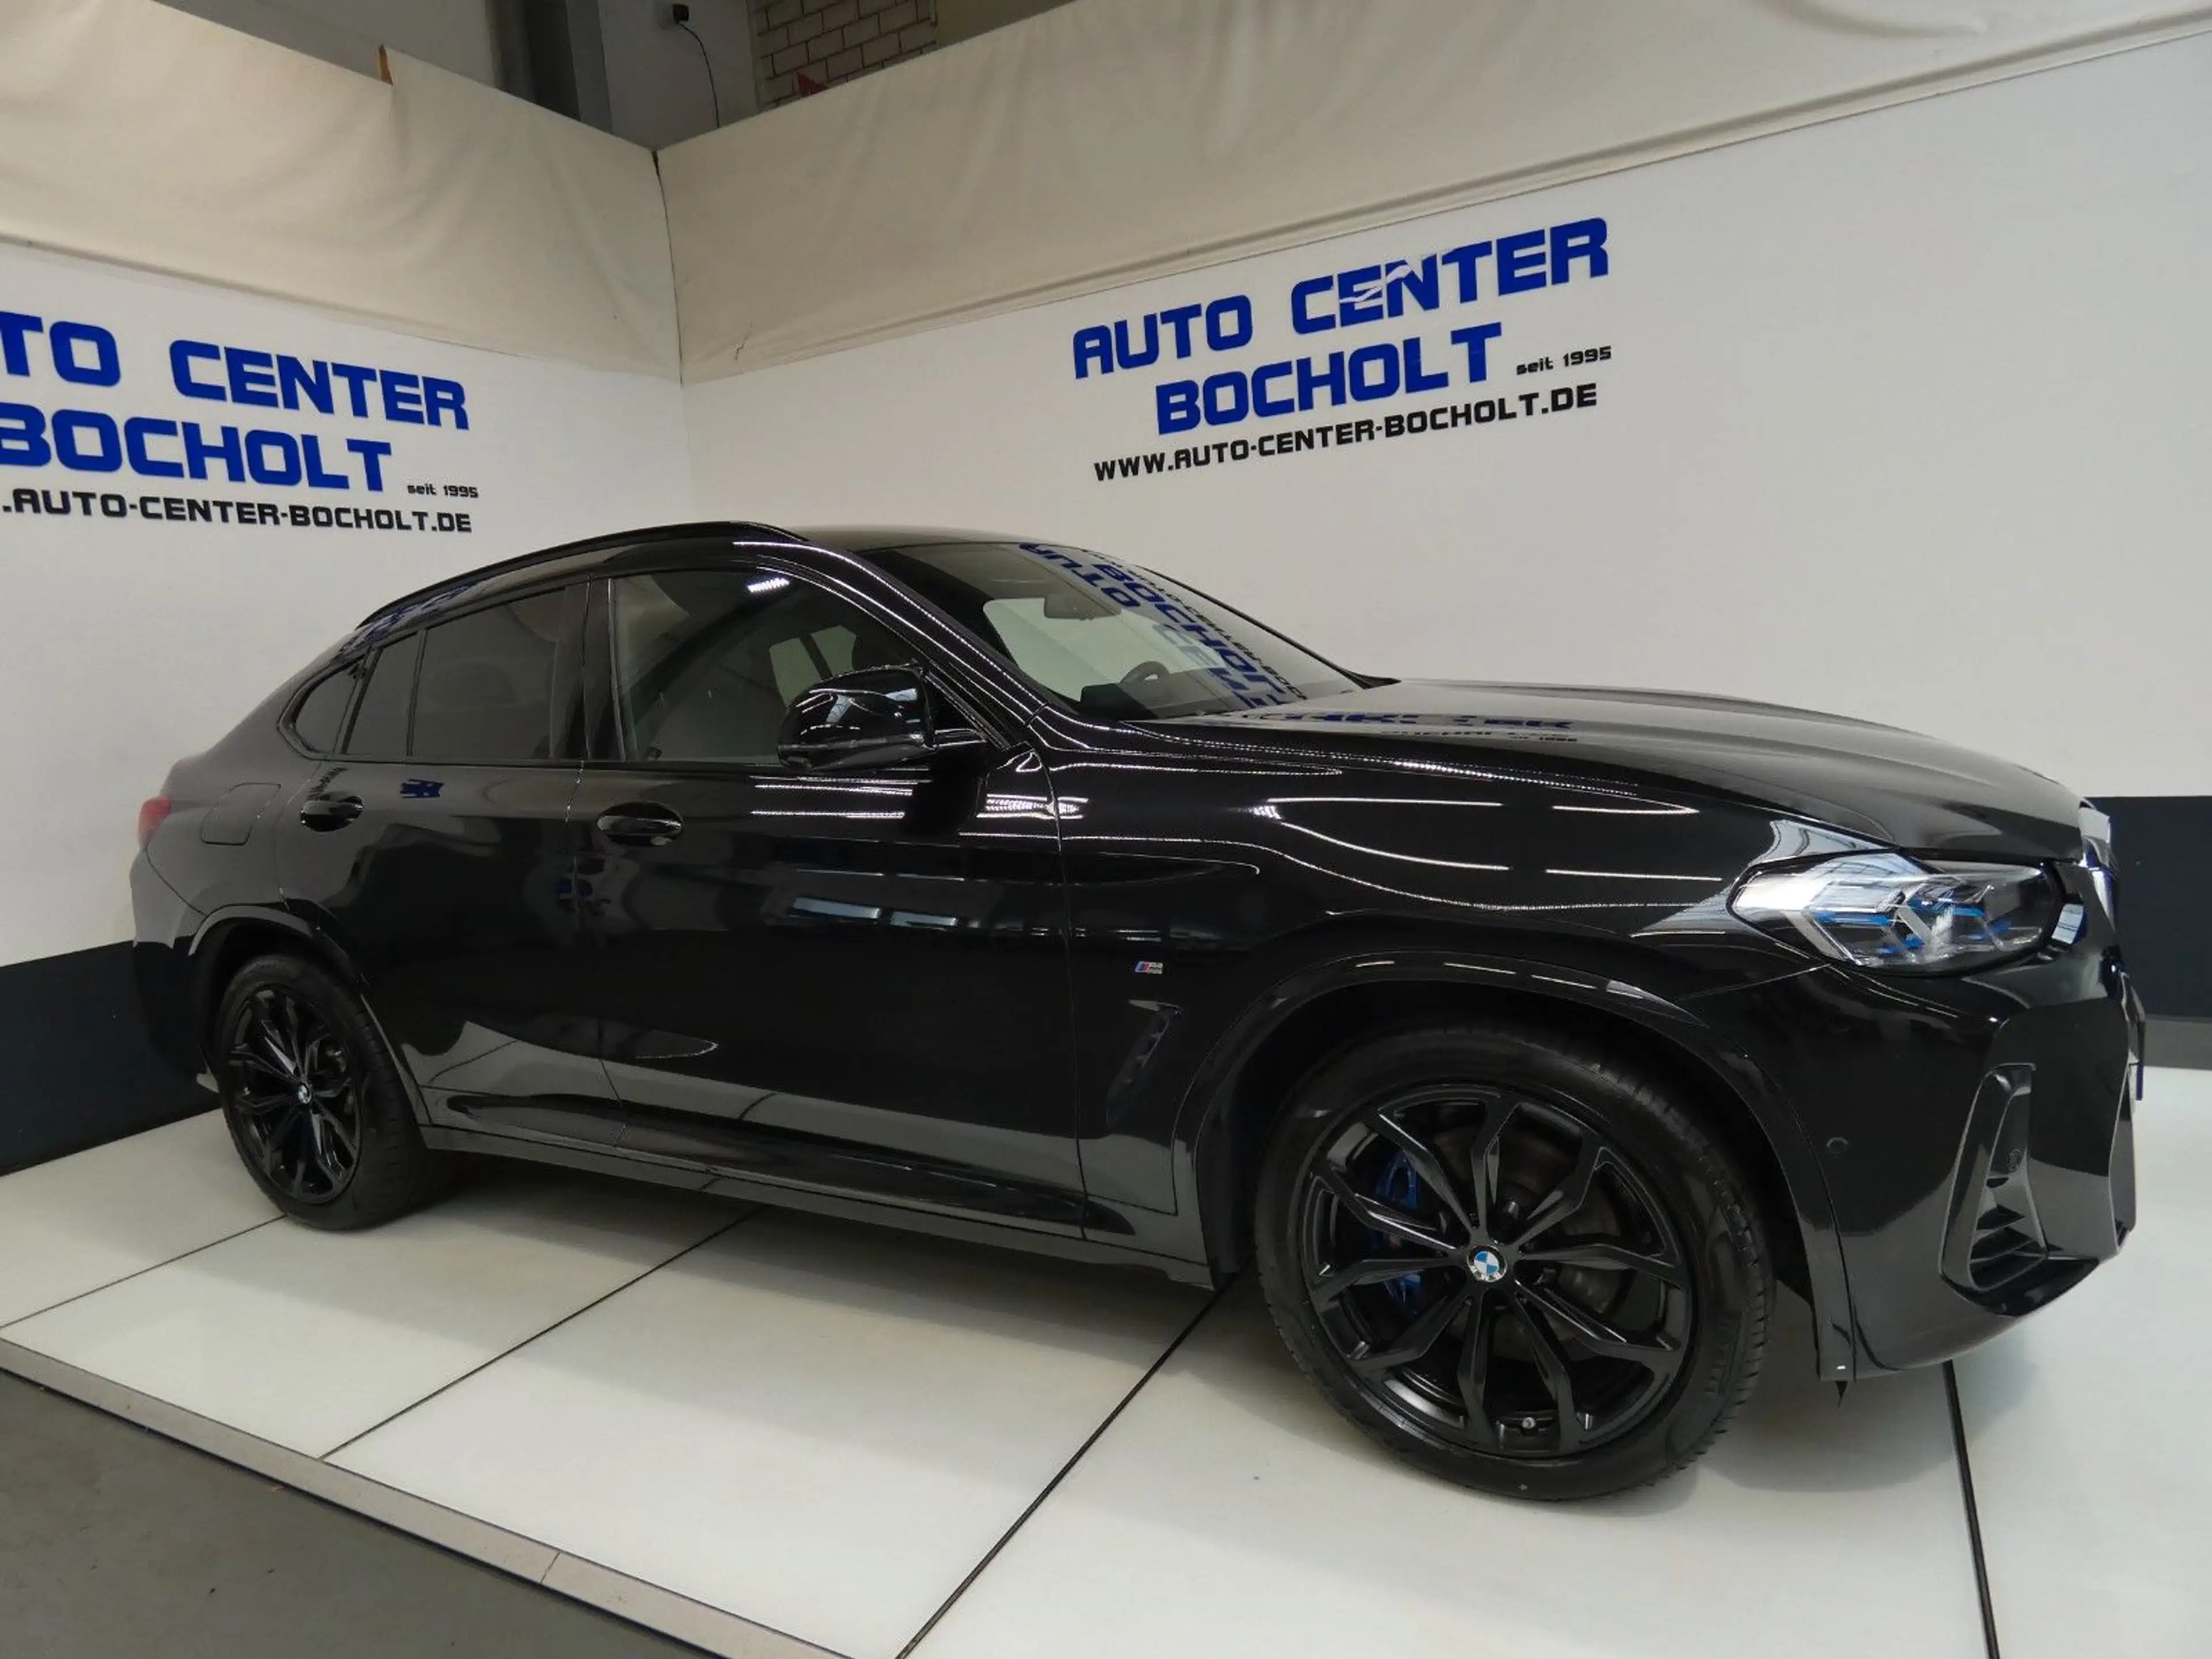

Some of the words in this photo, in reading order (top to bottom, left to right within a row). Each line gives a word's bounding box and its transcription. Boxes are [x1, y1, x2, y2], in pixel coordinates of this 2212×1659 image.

[1073, 295, 1253, 379] AUTO
[1291, 217, 1609, 335] CENTER
[169, 340, 469, 430] CENTER
[1156, 321, 1502, 435] BOCHOLT
[1516, 357, 1554, 375] seit
[1563, 346, 1612, 367] 1995
[0, 402, 392, 492] BOCHOLT
[407, 483, 437, 496] seit
[443, 485, 479, 499] 1995
